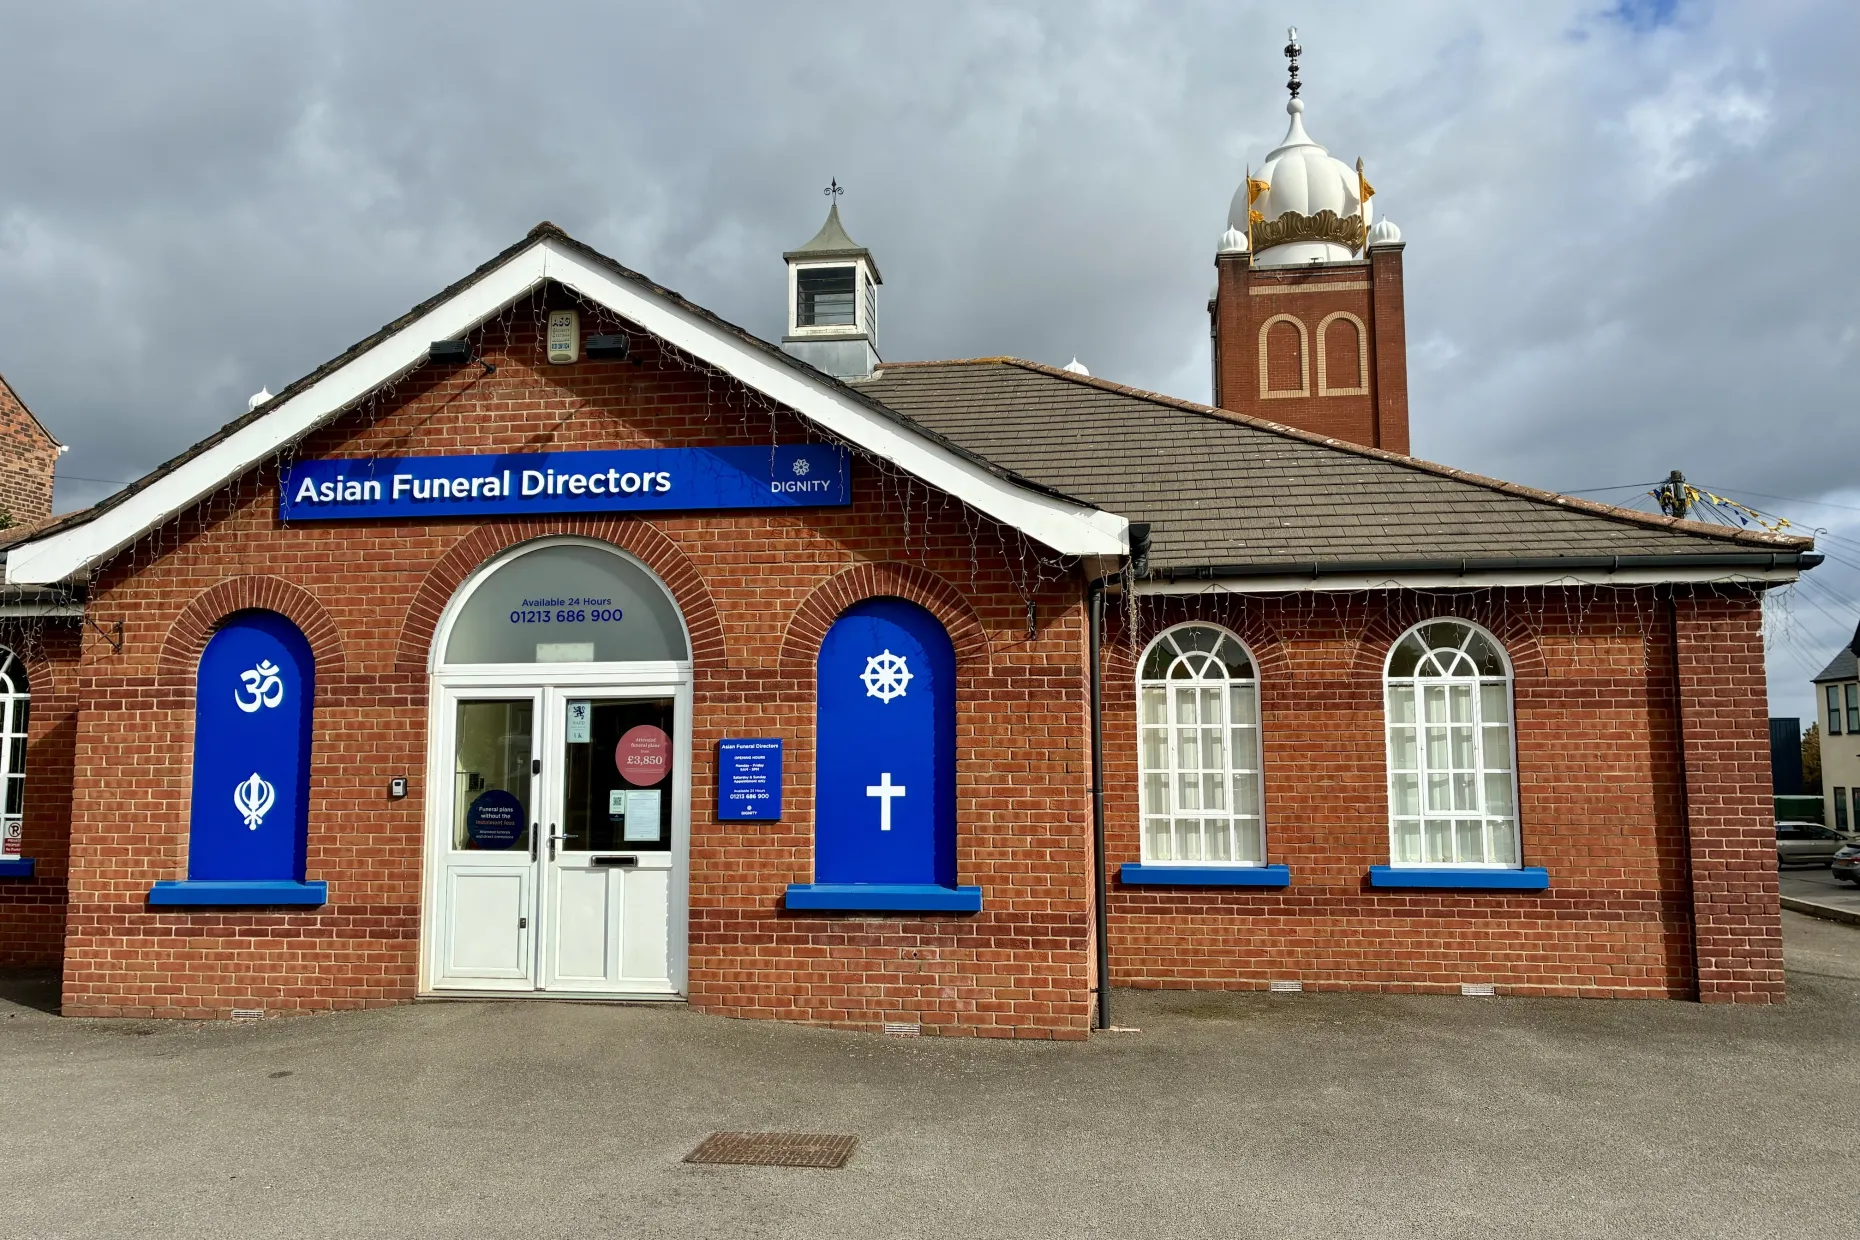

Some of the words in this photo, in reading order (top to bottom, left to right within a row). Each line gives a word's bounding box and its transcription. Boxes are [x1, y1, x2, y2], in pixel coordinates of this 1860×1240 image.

[295, 475, 381, 502] Asian
[392, 470, 510, 499] Funeral
[521, 468, 671, 496] Directors
[771, 480, 831, 493] DIGNITY
[522, 598, 565, 607] Available
[568, 598, 580, 606] 24
[583, 597, 612, 606] Hours
[510, 610, 551, 623] 01213
[556, 609, 585, 623] 686
[591, 608, 623, 622] 900
[627, 755, 663, 766] £3,850
